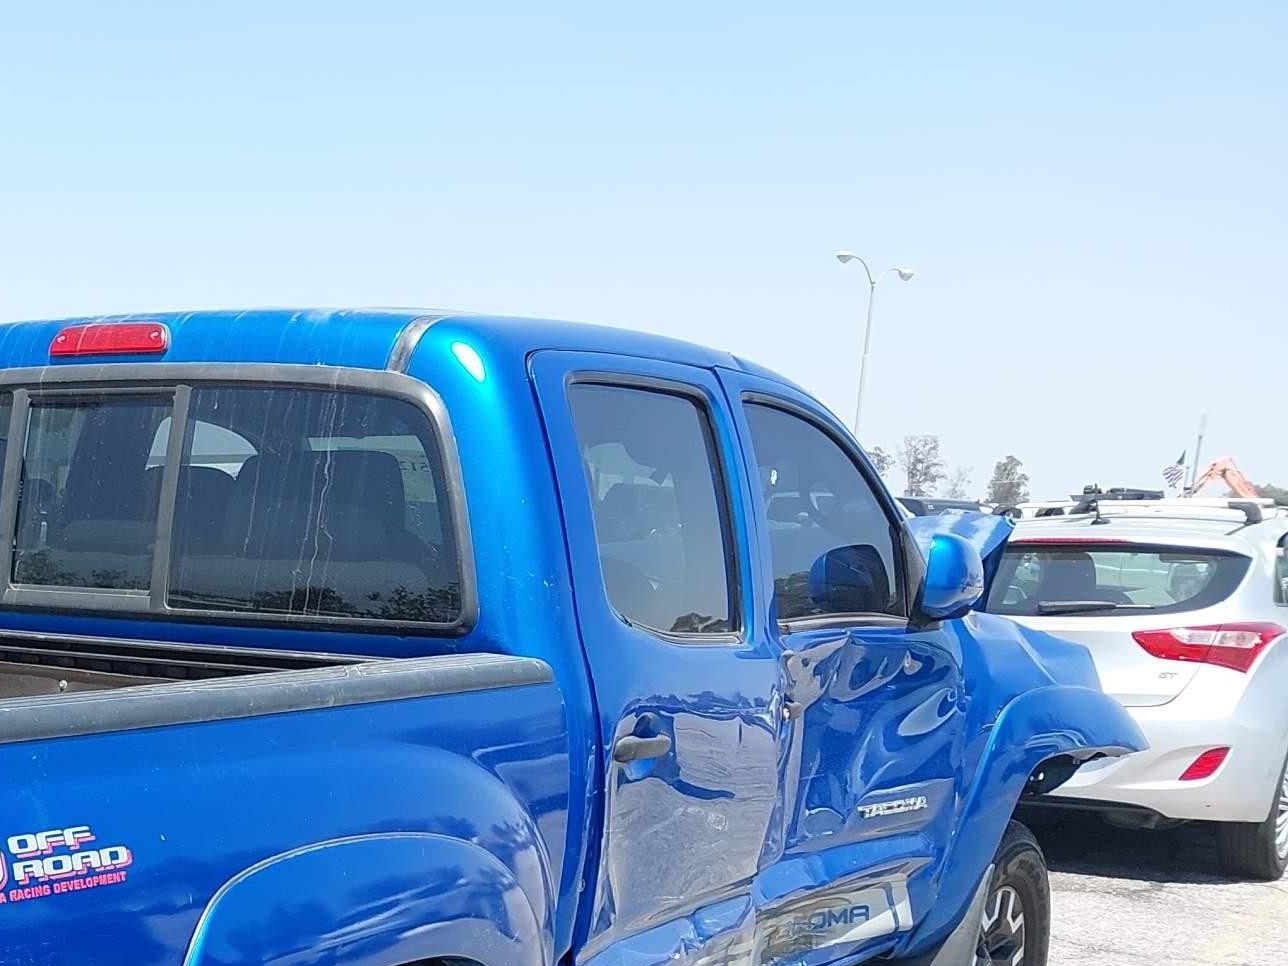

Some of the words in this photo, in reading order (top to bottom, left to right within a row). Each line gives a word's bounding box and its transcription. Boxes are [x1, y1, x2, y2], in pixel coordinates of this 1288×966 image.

[857, 796, 929, 819] TACOMA
[7, 826, 96, 858] OFF
[12, 846, 133, 885] ROAD
[9, 879, 52, 902] RACING
[53, 870, 128, 894] DEVELOPMENT
